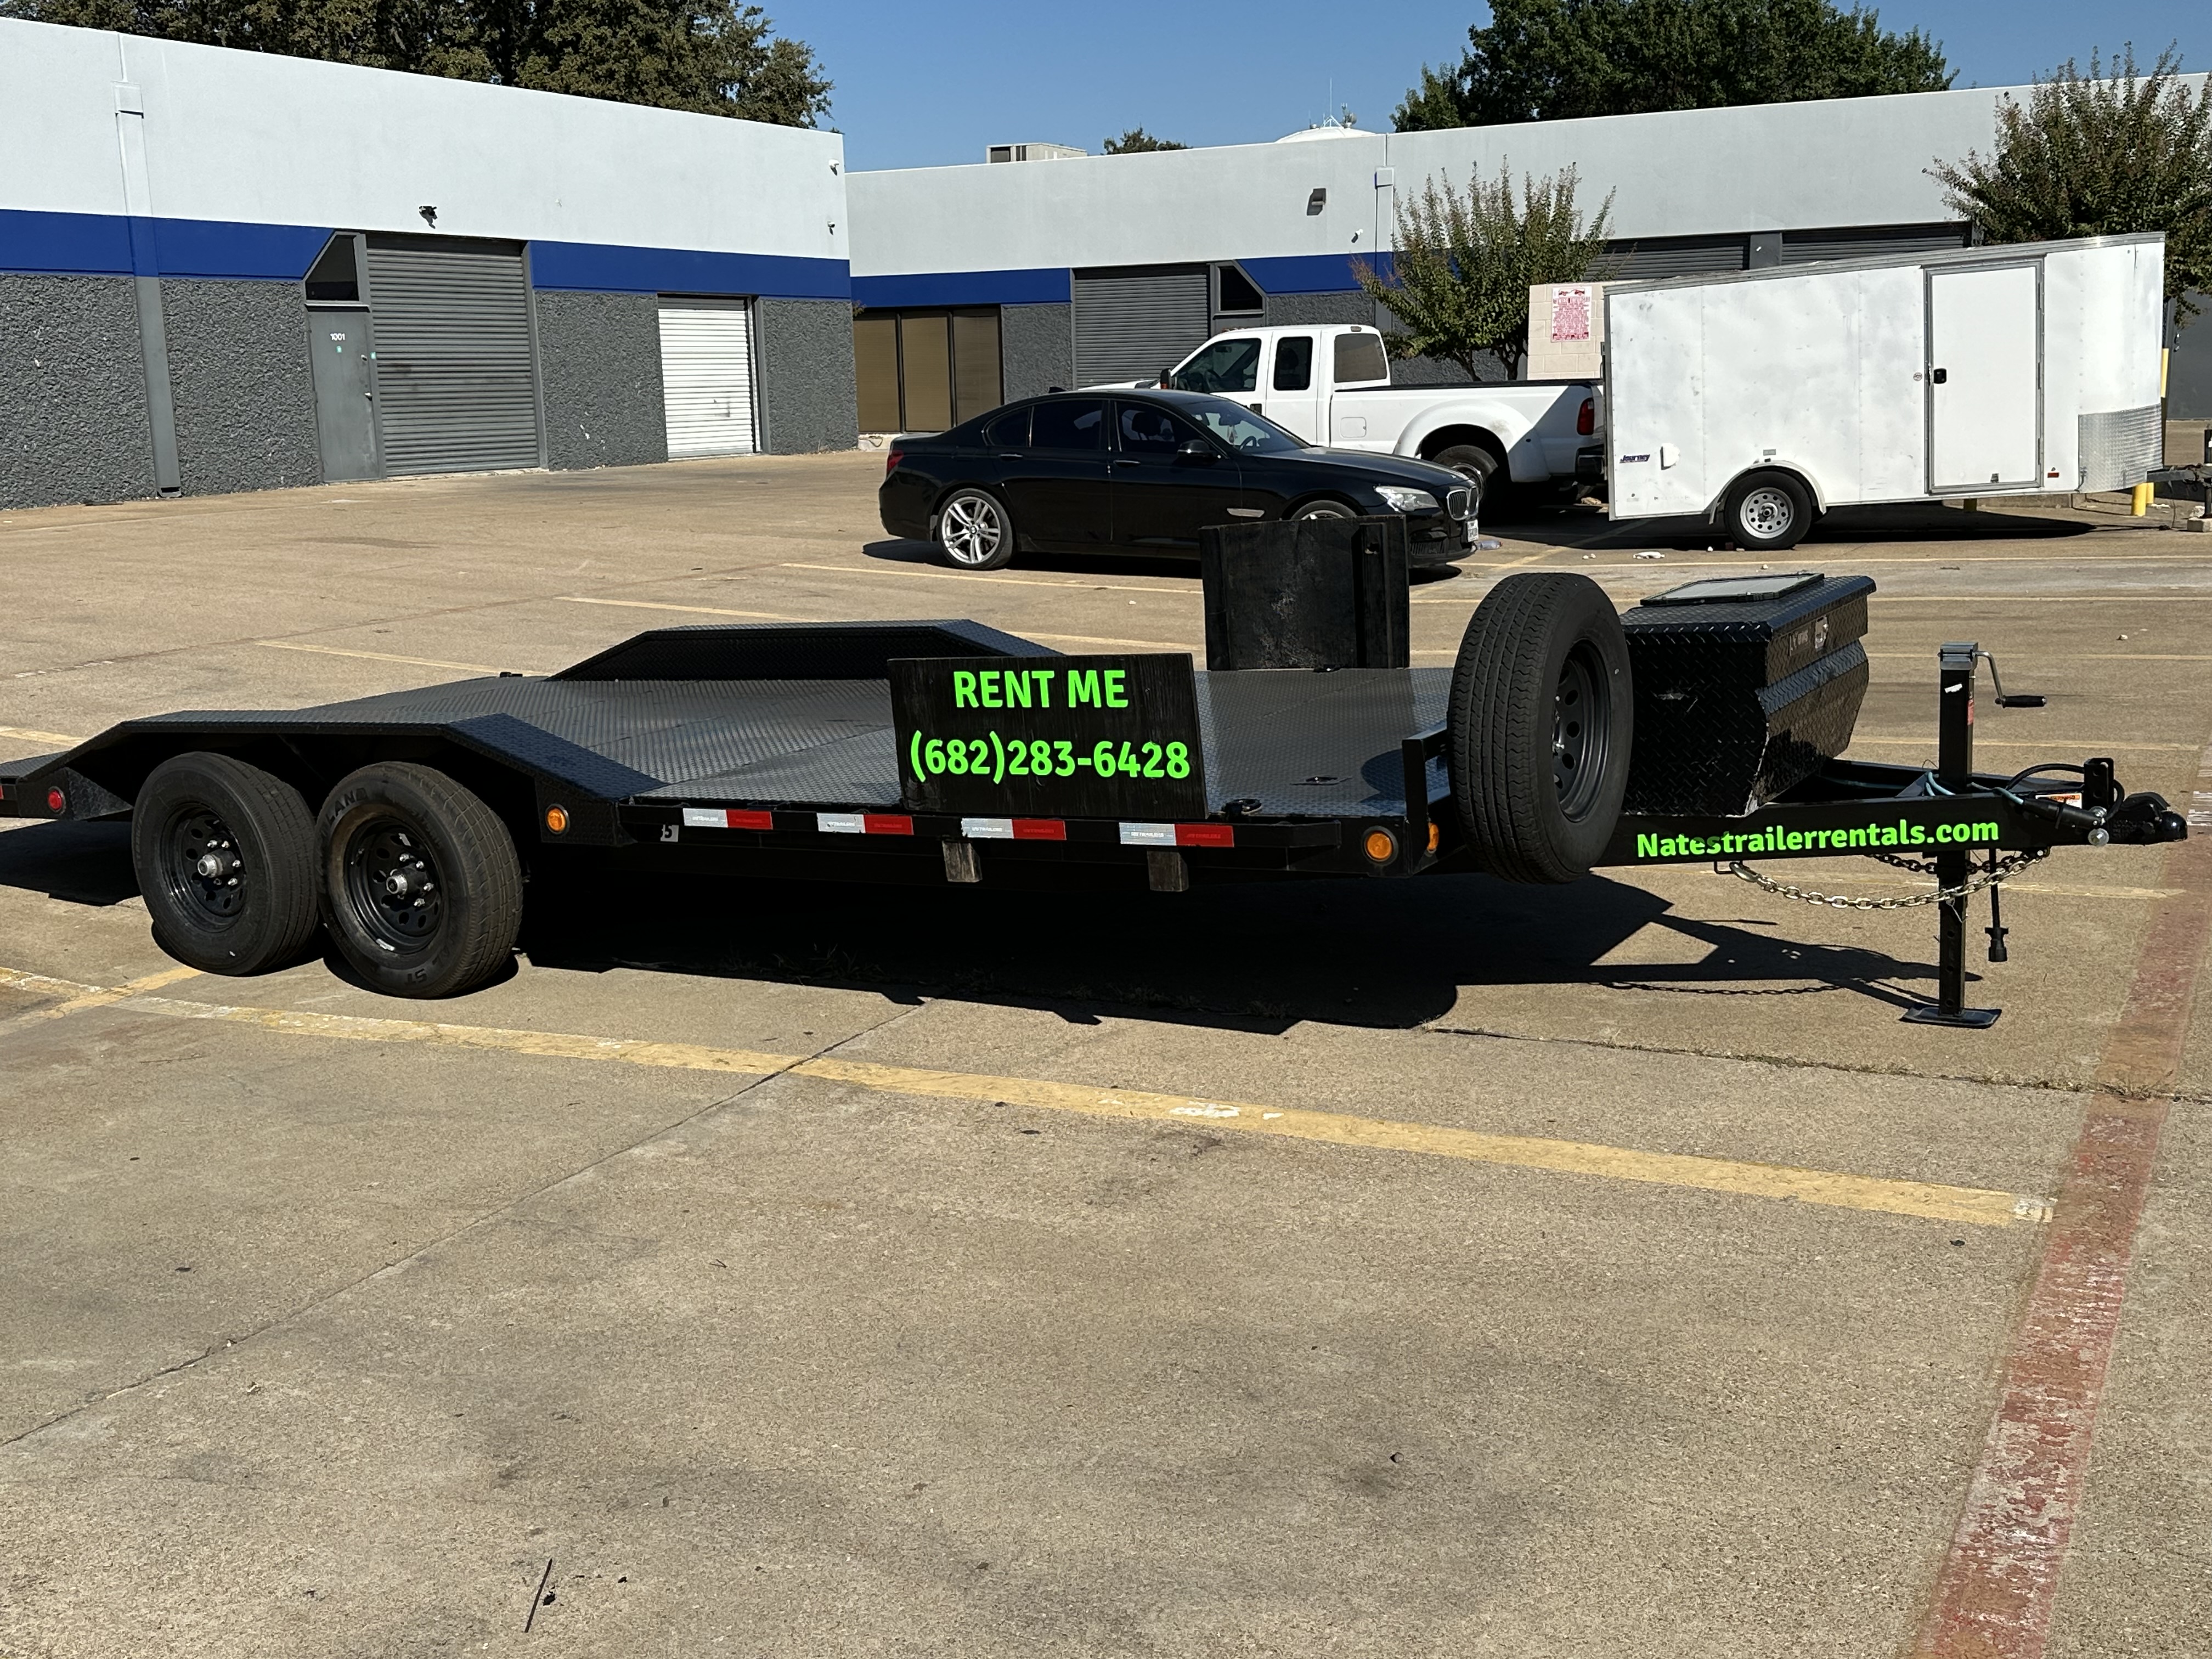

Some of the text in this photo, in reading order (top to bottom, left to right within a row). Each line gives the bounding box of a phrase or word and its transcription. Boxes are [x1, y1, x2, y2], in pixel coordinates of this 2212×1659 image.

[953, 669, 1128, 708] RENT ME
[911, 730, 1190, 785] (682)283-6428
[1637, 819, 1999, 857] Natestrailerrentals.com
